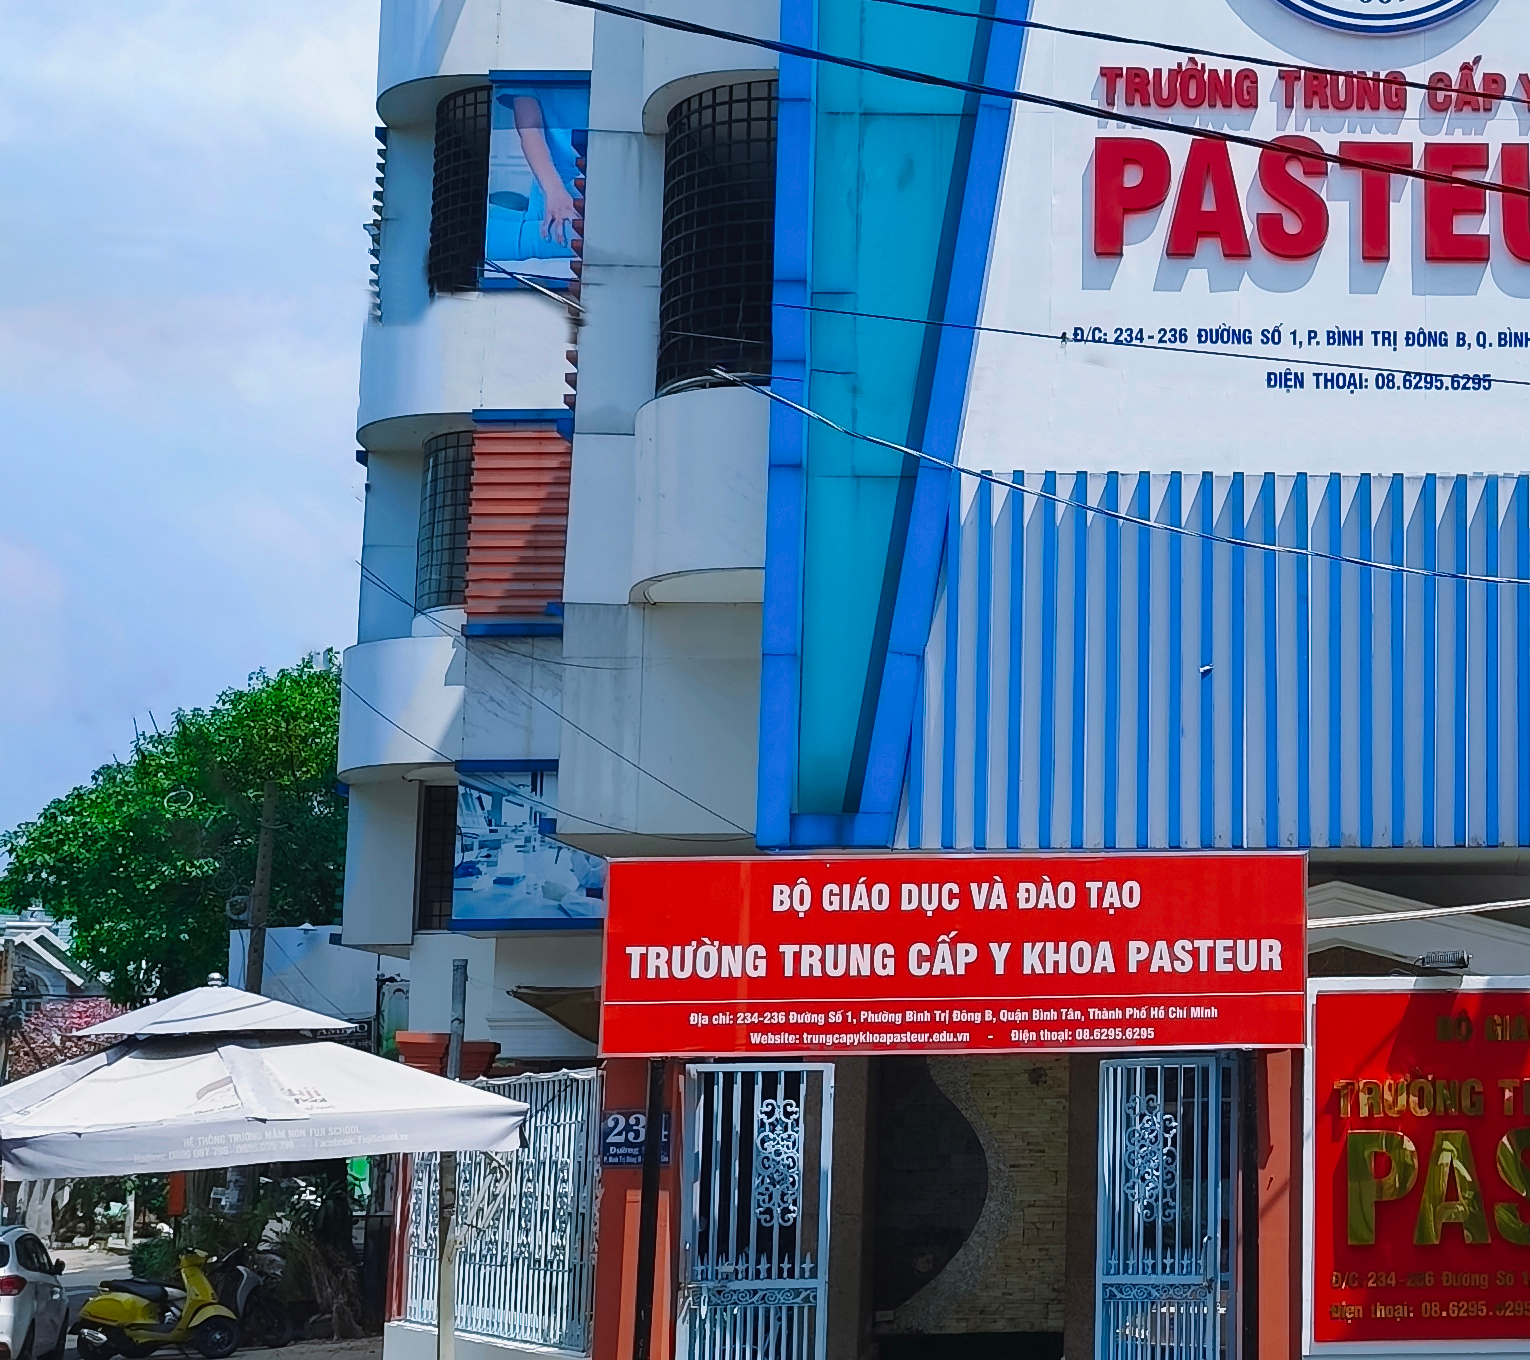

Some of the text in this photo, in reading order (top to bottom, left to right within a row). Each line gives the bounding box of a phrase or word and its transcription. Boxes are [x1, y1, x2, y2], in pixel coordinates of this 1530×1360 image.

[1100, 57, 1258, 109] TRƯỜNG
[1278, 68, 1408, 111] TRUNG
[1427, 55, 1507, 113] CẤP
[1072, 326, 1108, 344] Đ/C:
[1197, 323, 1252, 346] ĐƯỜNG
[1260, 322, 1284, 346] SỐ
[1307, 328, 1321, 346] P.
[1326, 325, 1364, 347] BÌNH
[1371, 330, 1398, 352] TRỊ
[1404, 327, 1449, 348] ĐÔNG
[1455, 331, 1472, 351] B,
[1475, 330, 1493, 350] Q.
[1266, 368, 1492, 394] ĐIỆN THOẠI: 08.6295.6295
[771, 876, 1142, 919] BỘ GIÁO DỤC VÀ ĐÀO TẠO
[625, 931, 1284, 980] TRƯỜNG TRUNG CẤP Y KHOA PASTEUR
[689, 1005, 1218, 1027] Địa chỉ: 234-236 Đường Số 1, Phường Bình Trị Đông B, Quận Bình Tân, Thành Phố Hồ Chí Minh
[750, 1031, 800, 1046] Website:
[803, 1030, 970, 1047] trungcapykhoapasteur.edu.vn
[1011, 1028, 1037, 1044] Điện
[1040, 1027, 1073, 1044] thoại:
[1075, 1027, 1155, 1042] 08.6295.6295
[1333, 1067, 1484, 1118] TRƯỜNG
[328, 1124, 362, 1137] SCHOOL
